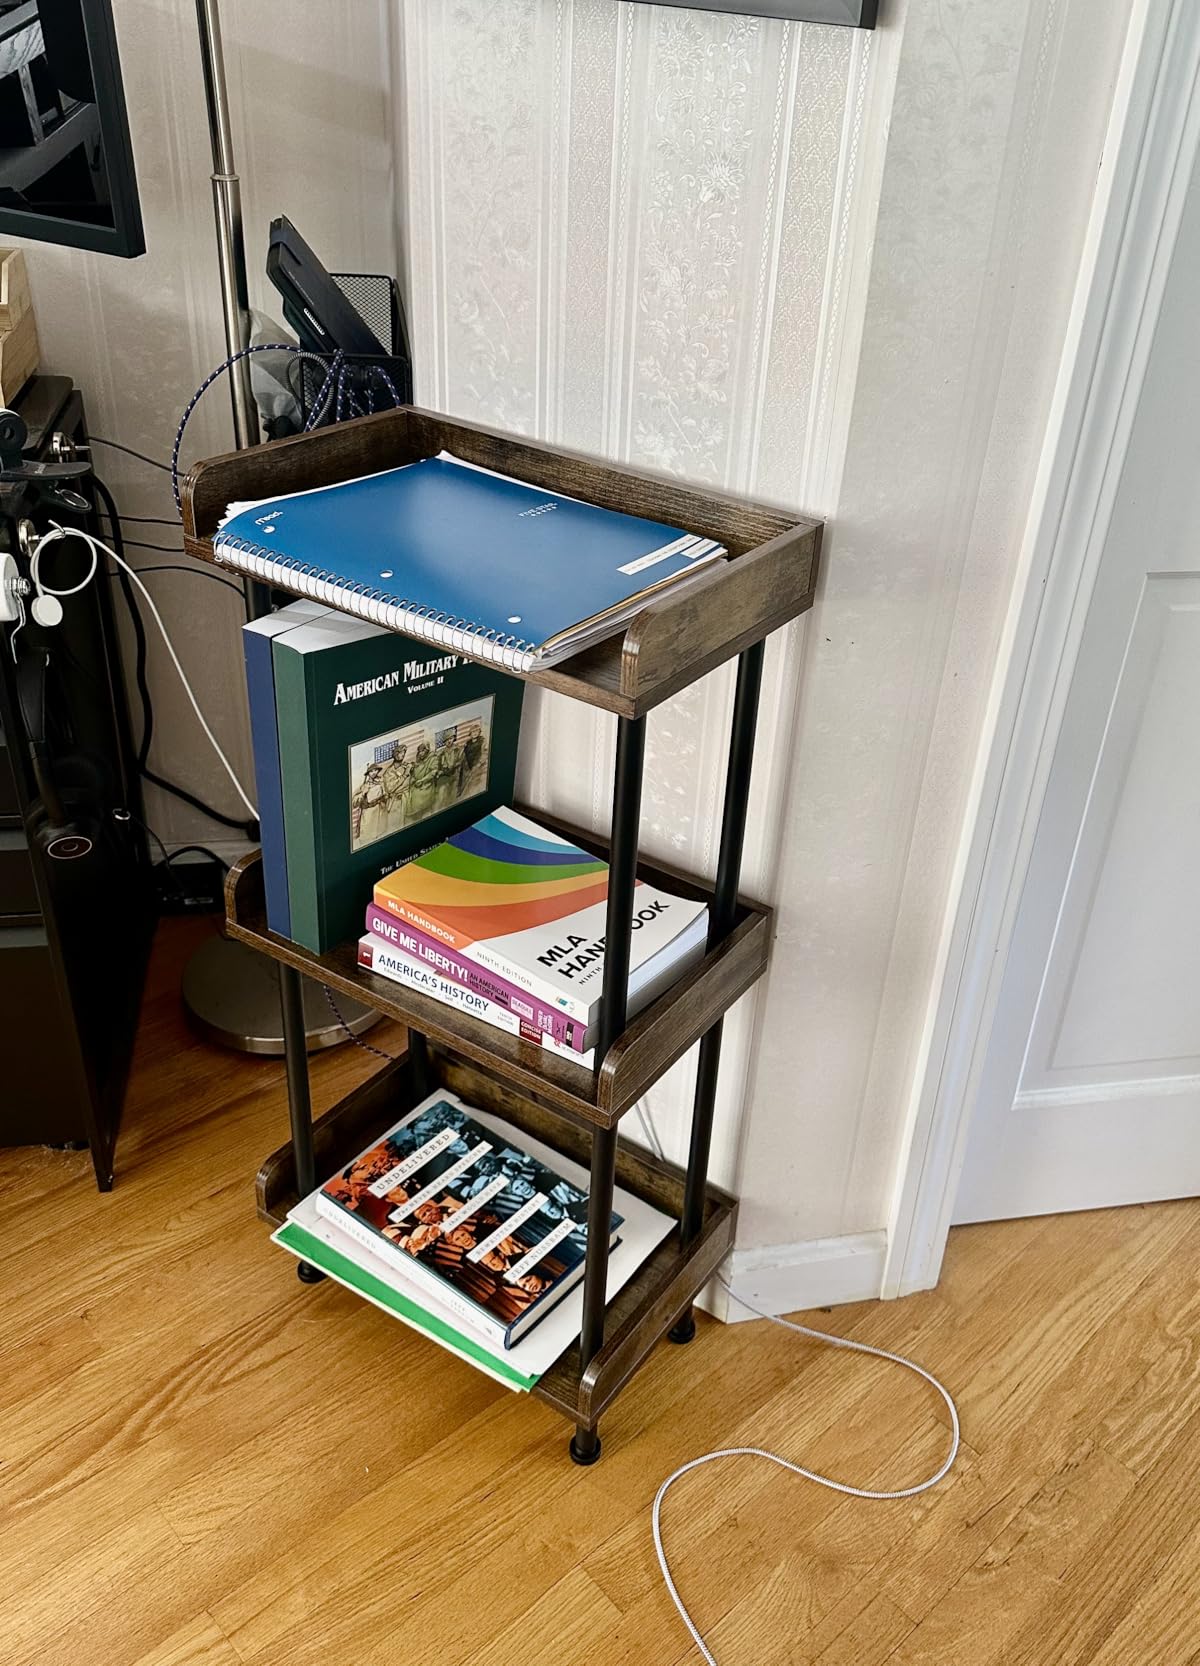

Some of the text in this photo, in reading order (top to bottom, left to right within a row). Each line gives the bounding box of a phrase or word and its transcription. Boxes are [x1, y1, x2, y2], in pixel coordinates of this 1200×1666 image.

[333, 654, 459, 706] AMERICAN MILITARY
[407, 675, 445, 694] VOLUME II
[372, 917, 469, 982] GIVE ME LIBERTY!
[387, 900, 533, 987] MLA HANDBOOK NINTH EDITION
[536, 934, 588, 967] MLA
[557, 900, 671, 979] HANOOK
[378, 954, 489, 1011] AMERICA'S HISTORY
[469, 980, 494, 997] HISTORY
[470, 973, 509, 1000] AN AMERICAN
[578, 966, 602, 986] NINTH
[520, 1027, 541, 1040] EDITION
[376, 1133, 451, 1191] UNDELIVERED
